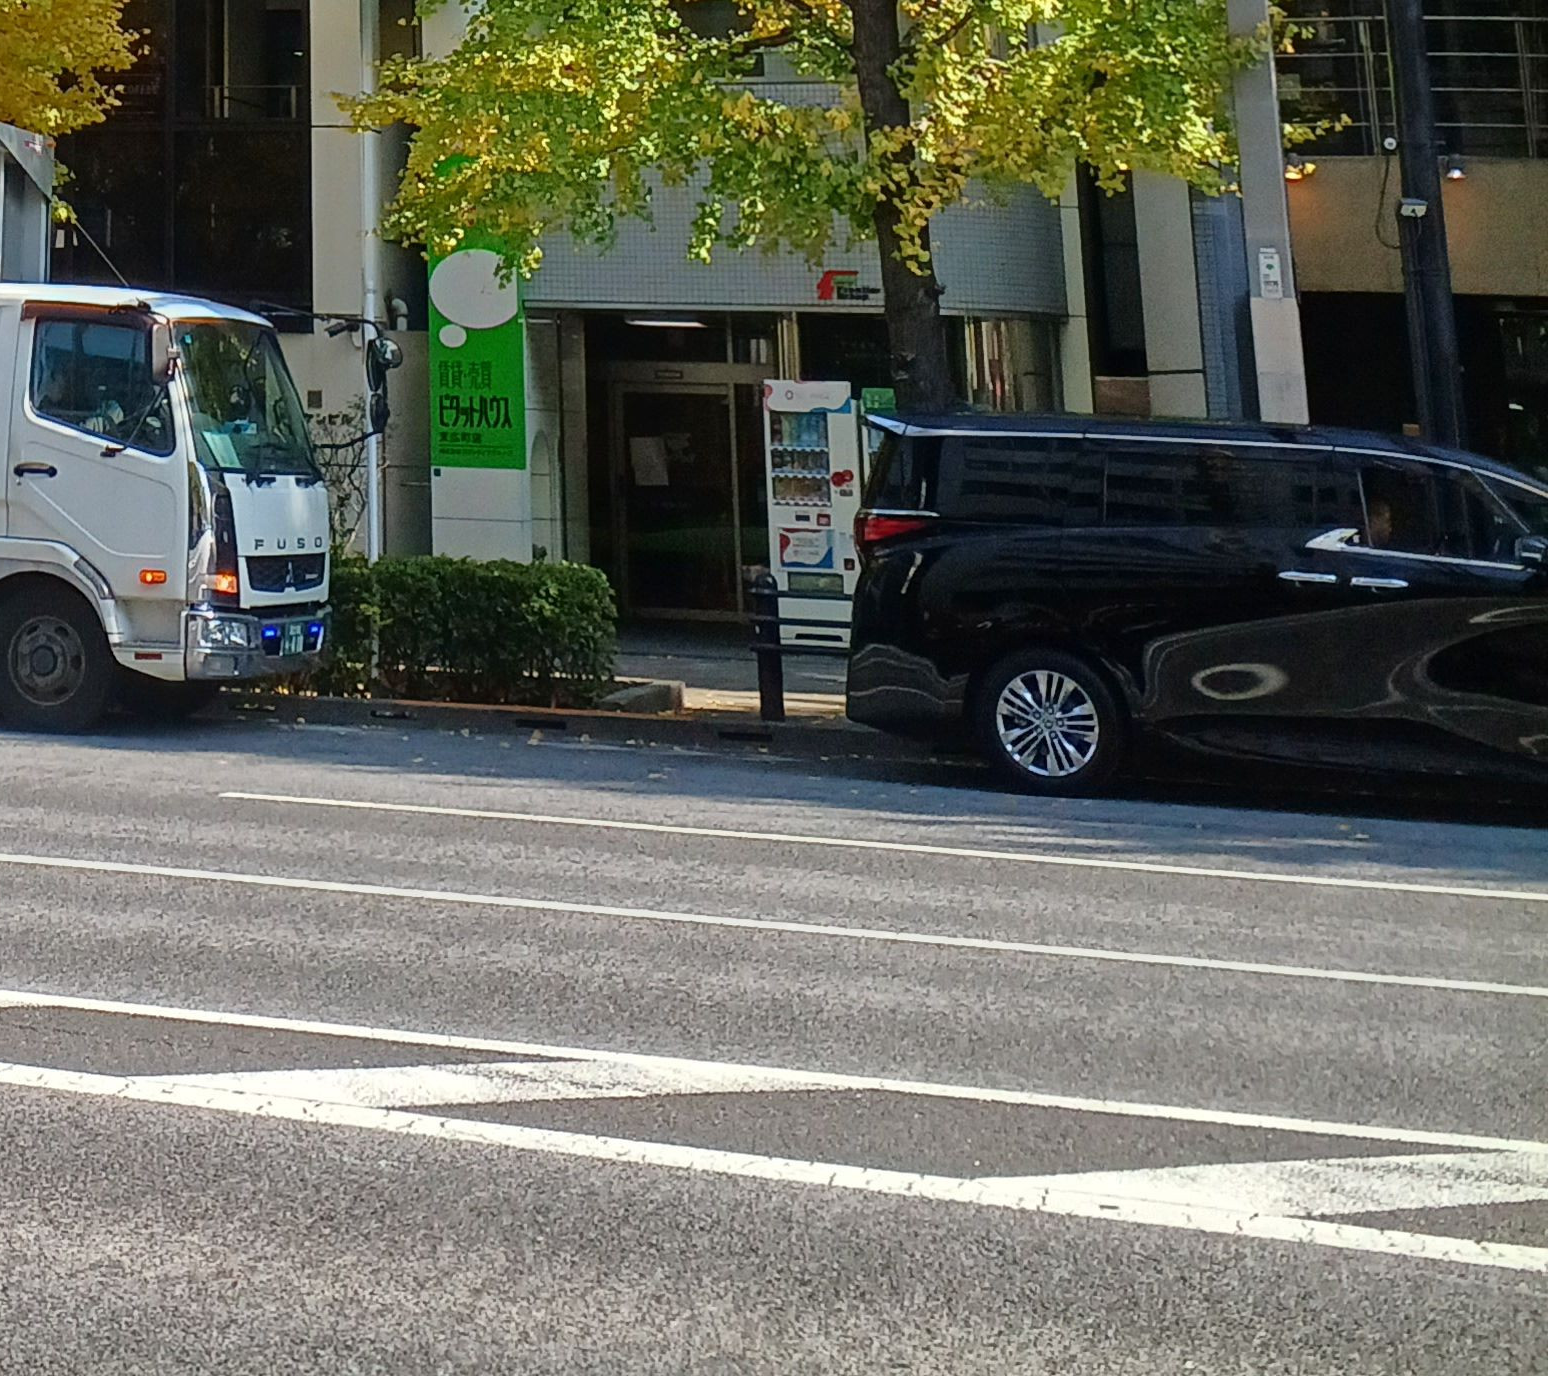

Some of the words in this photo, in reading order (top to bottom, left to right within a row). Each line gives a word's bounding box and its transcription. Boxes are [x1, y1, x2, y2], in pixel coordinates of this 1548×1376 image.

[438, 393, 513, 429] ピタットハウス
[254, 536, 323, 551] FUSO
